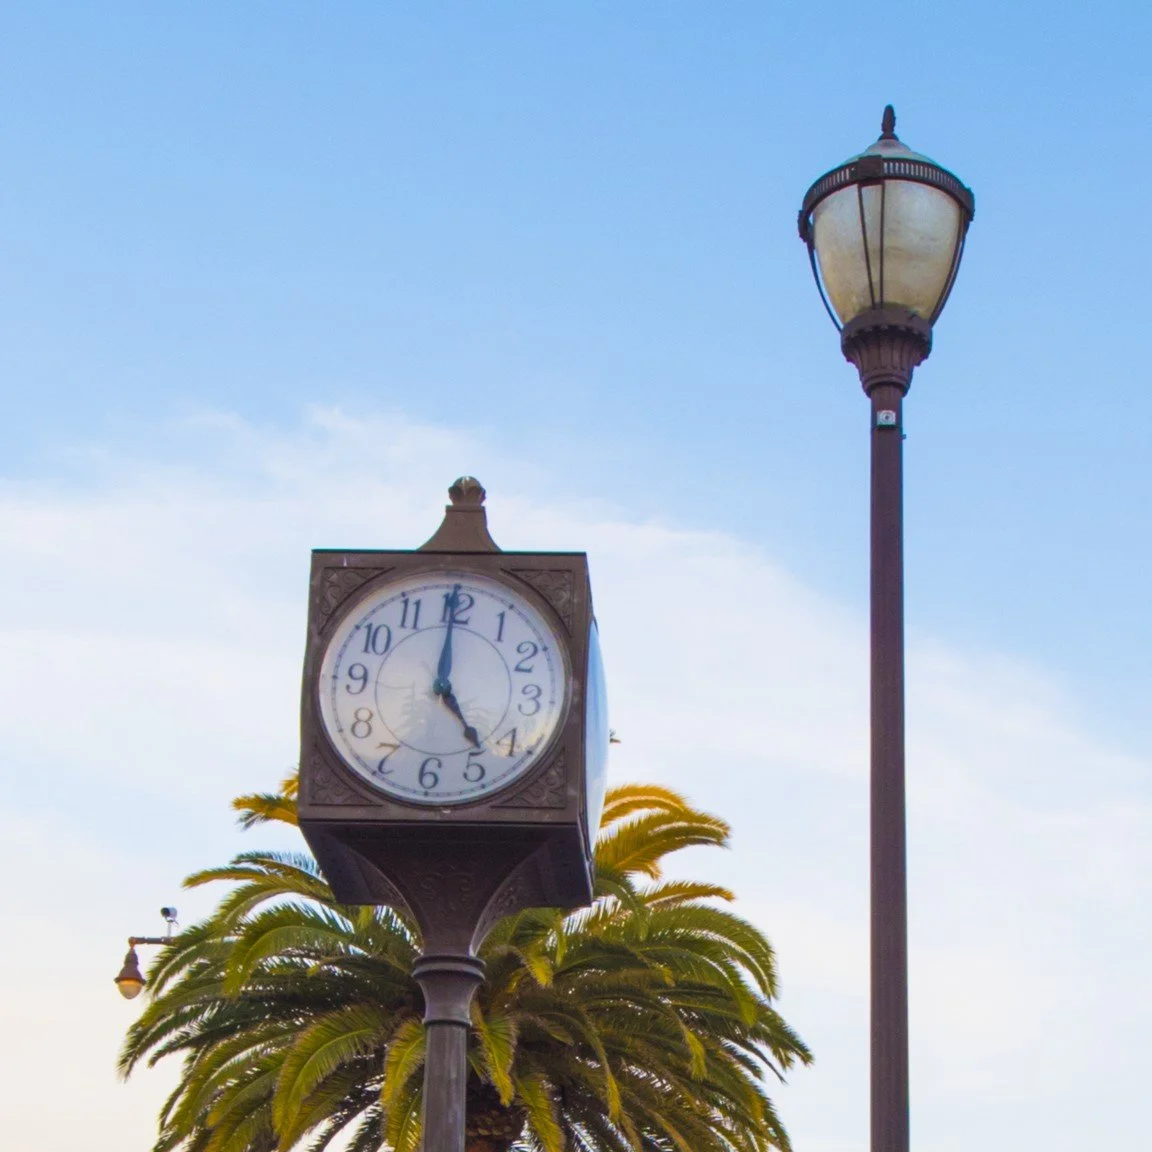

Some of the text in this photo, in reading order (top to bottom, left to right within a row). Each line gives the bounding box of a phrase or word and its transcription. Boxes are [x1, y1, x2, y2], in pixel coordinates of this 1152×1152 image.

[399, 597, 422, 630] 11
[440, 593, 475, 624] 12
[362, 623, 392, 655] 10
[494, 611, 506, 642] 1
[514, 641, 538, 673] 2
[345, 662, 369, 695] 9
[518, 684, 543, 716] 3
[350, 707, 373, 739] 8
[376, 742, 400, 774] 7
[497, 727, 517, 757] 4
[418, 757, 442, 789] 6
[463, 751, 486, 782] 5
